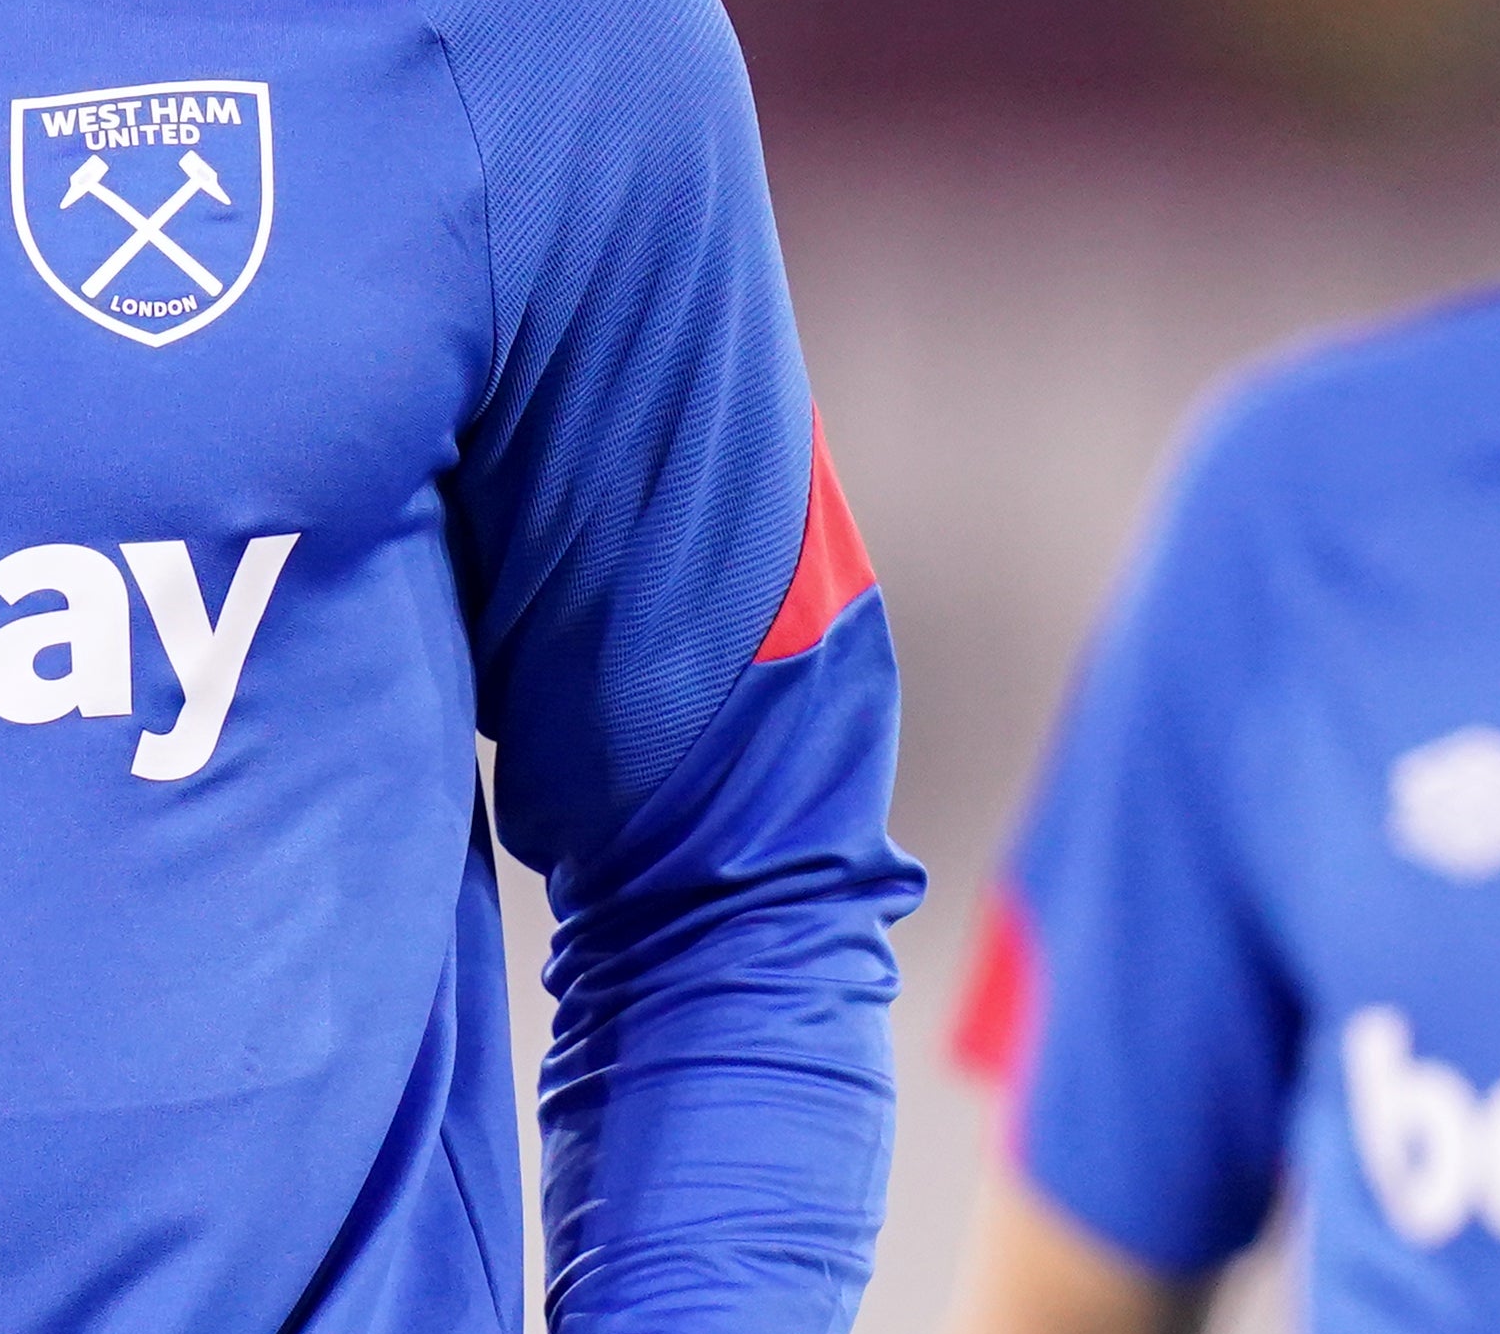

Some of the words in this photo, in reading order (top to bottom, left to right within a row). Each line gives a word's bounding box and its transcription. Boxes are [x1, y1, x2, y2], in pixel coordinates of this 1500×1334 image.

[41, 100, 142, 138] WEST
[149, 96, 242, 125] HAM
[84, 123, 201, 151] UNITED
[109, 294, 198, 318] LONDON
